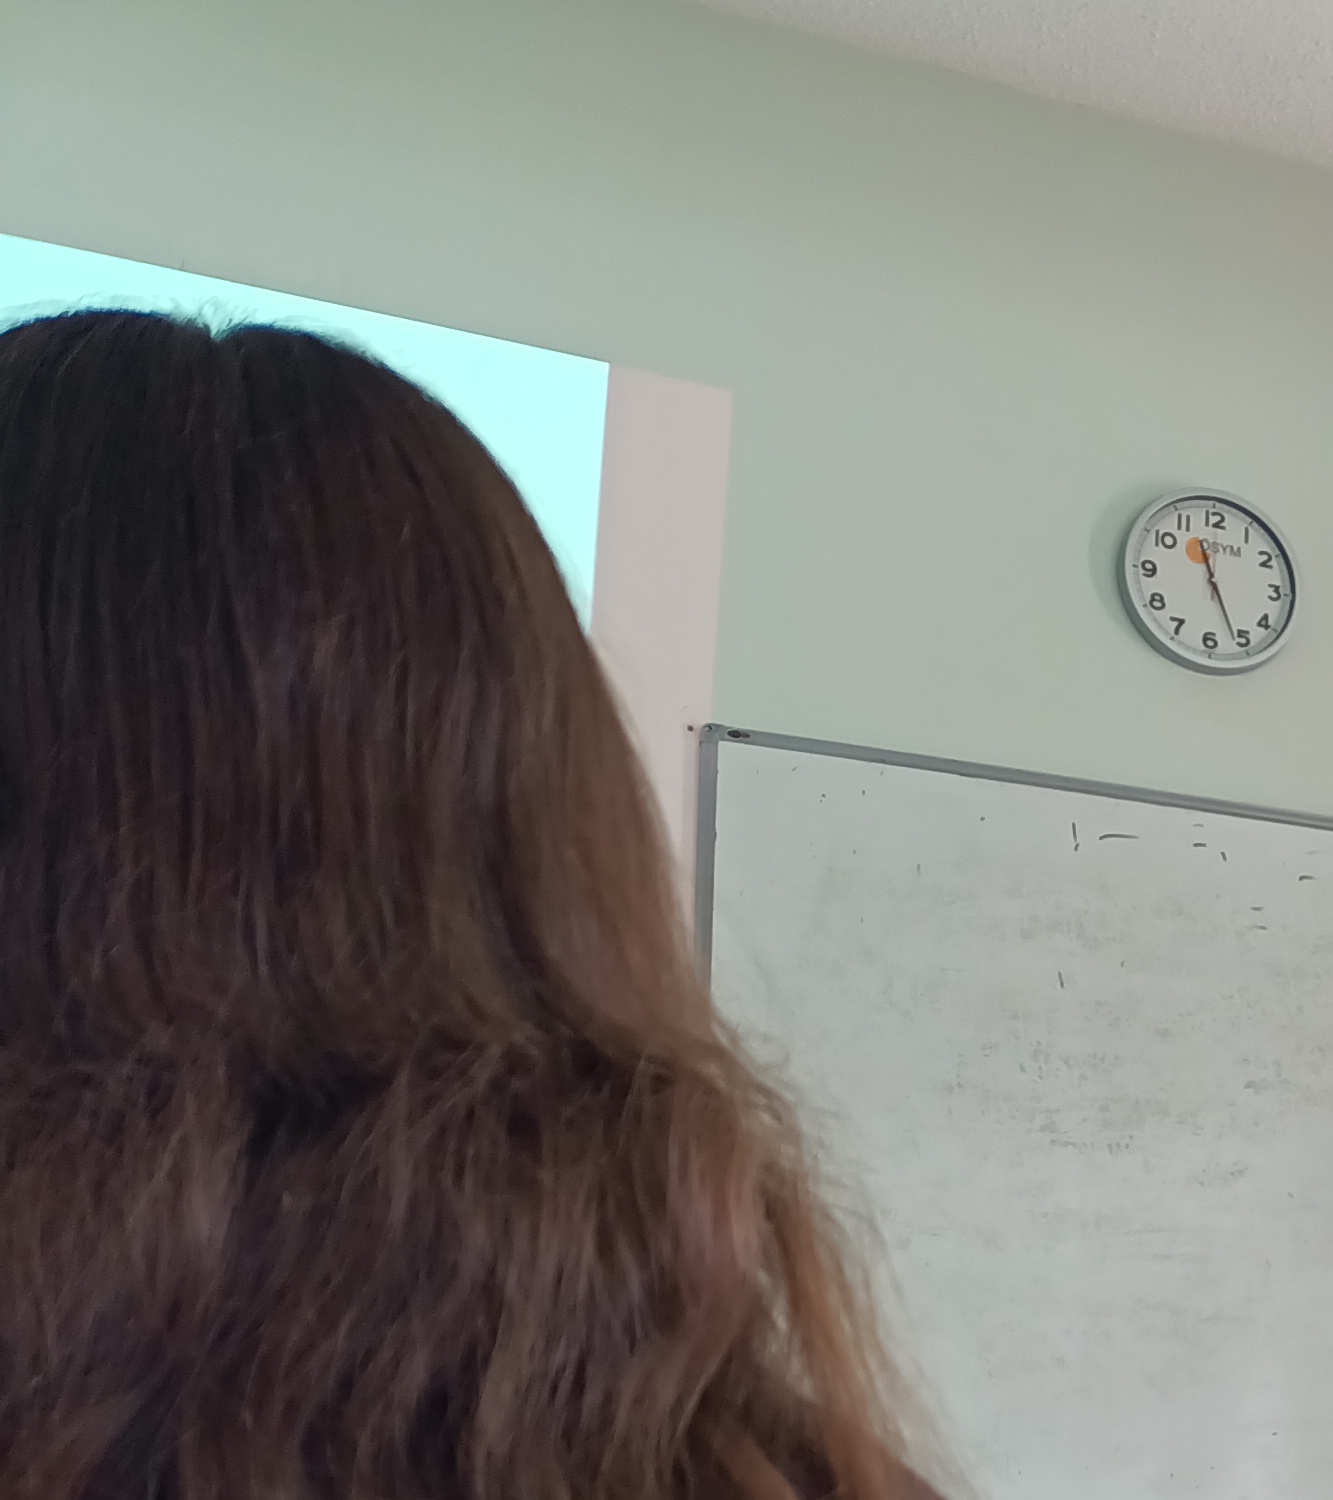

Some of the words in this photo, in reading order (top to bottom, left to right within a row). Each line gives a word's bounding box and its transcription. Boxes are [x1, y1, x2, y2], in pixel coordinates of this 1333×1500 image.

[1177, 513, 1190, 532] 11
[1205, 510, 1226, 530] 12
[1155, 530, 1177, 549] 10
[1244, 527, 1249, 544] 1
[1141, 560, 1157, 578] 9
[1257, 551, 1273, 569] 2
[1149, 593, 1165, 610] 8
[1267, 584, 1281, 602] 3
[1169, 617, 1185, 635] 7
[1256, 613, 1270, 630] 4
[1202, 632, 1218, 649] 6
[1235, 629, 1250, 647] 5
